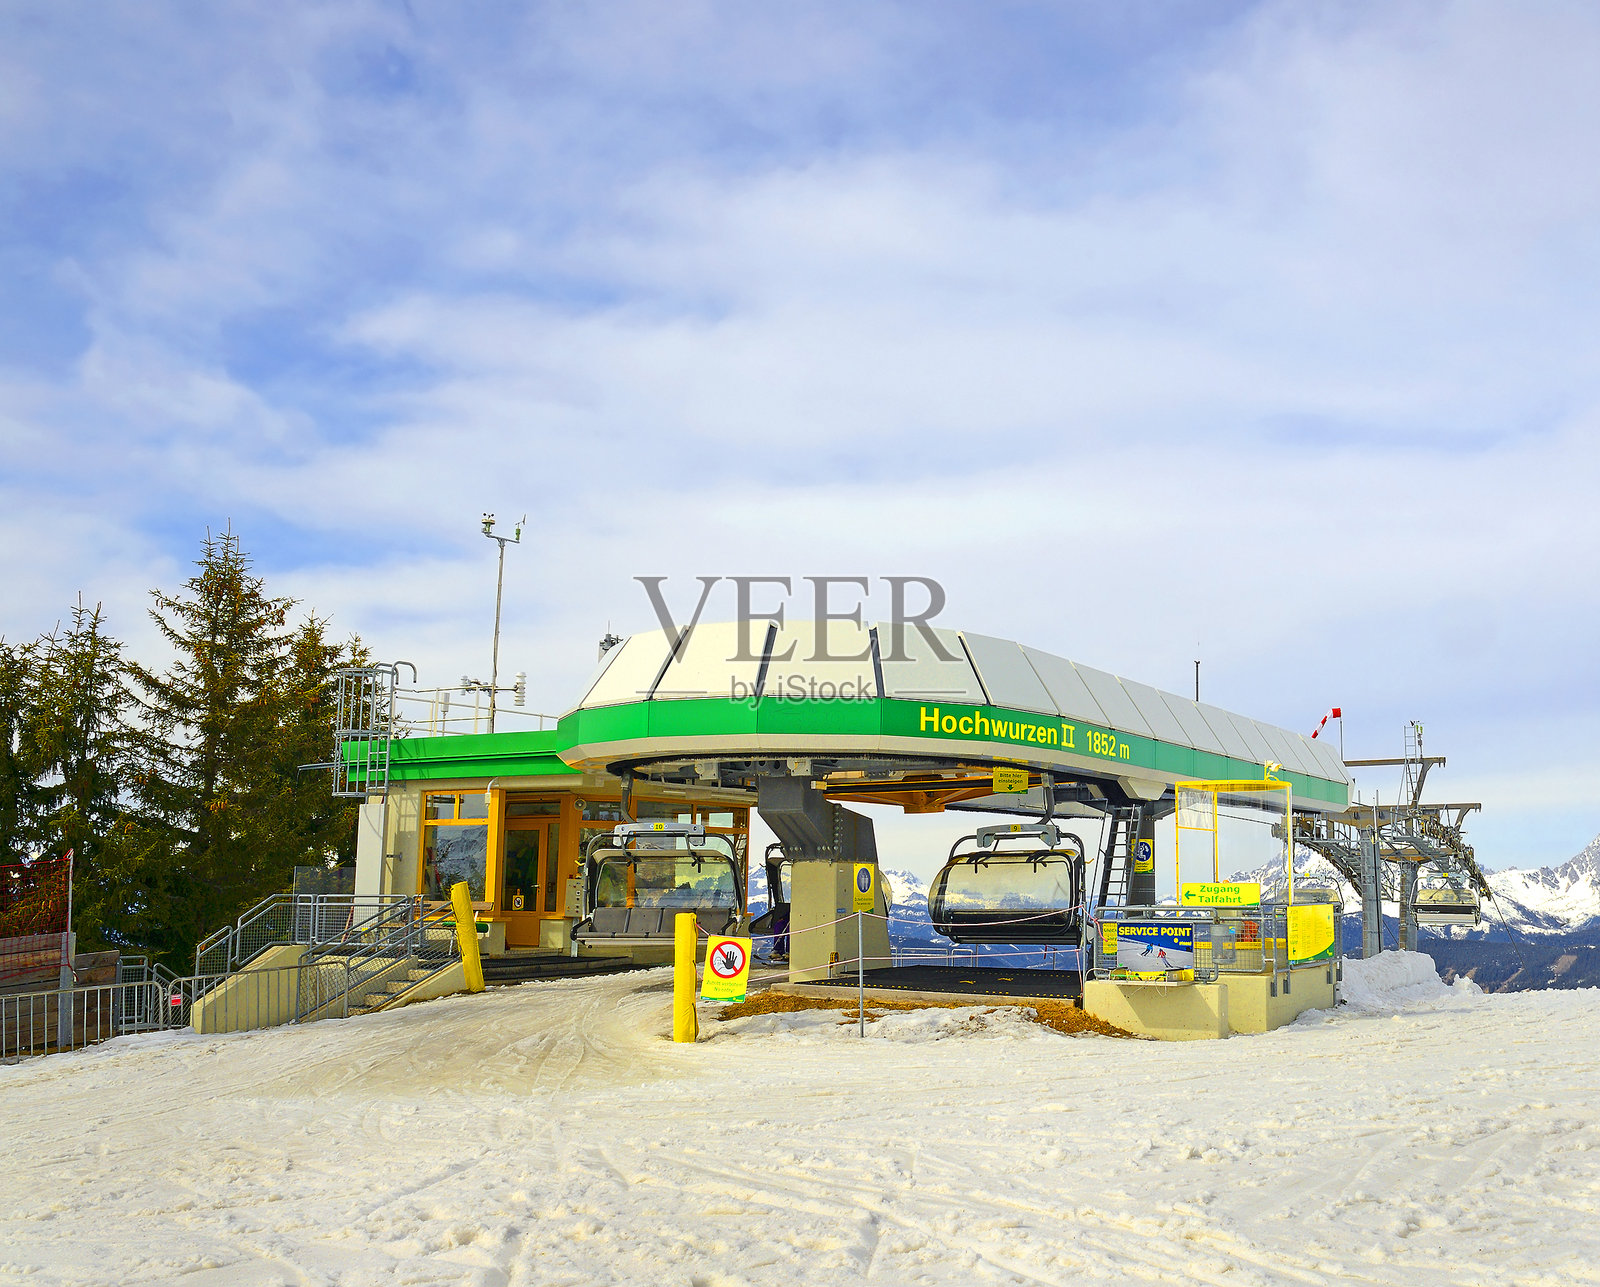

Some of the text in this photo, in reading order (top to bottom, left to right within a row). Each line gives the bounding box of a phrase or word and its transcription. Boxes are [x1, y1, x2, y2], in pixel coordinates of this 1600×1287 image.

[919, 706, 1058, 745] Hochwurzen
[1086, 730, 1116, 757] 1852
[1119, 743, 1130, 760] m
[1200, 885, 1240, 894] Zugang
[1199, 895, 1242, 903] Talfahrt
[1118, 926, 1192, 936] SERVICE POINT
